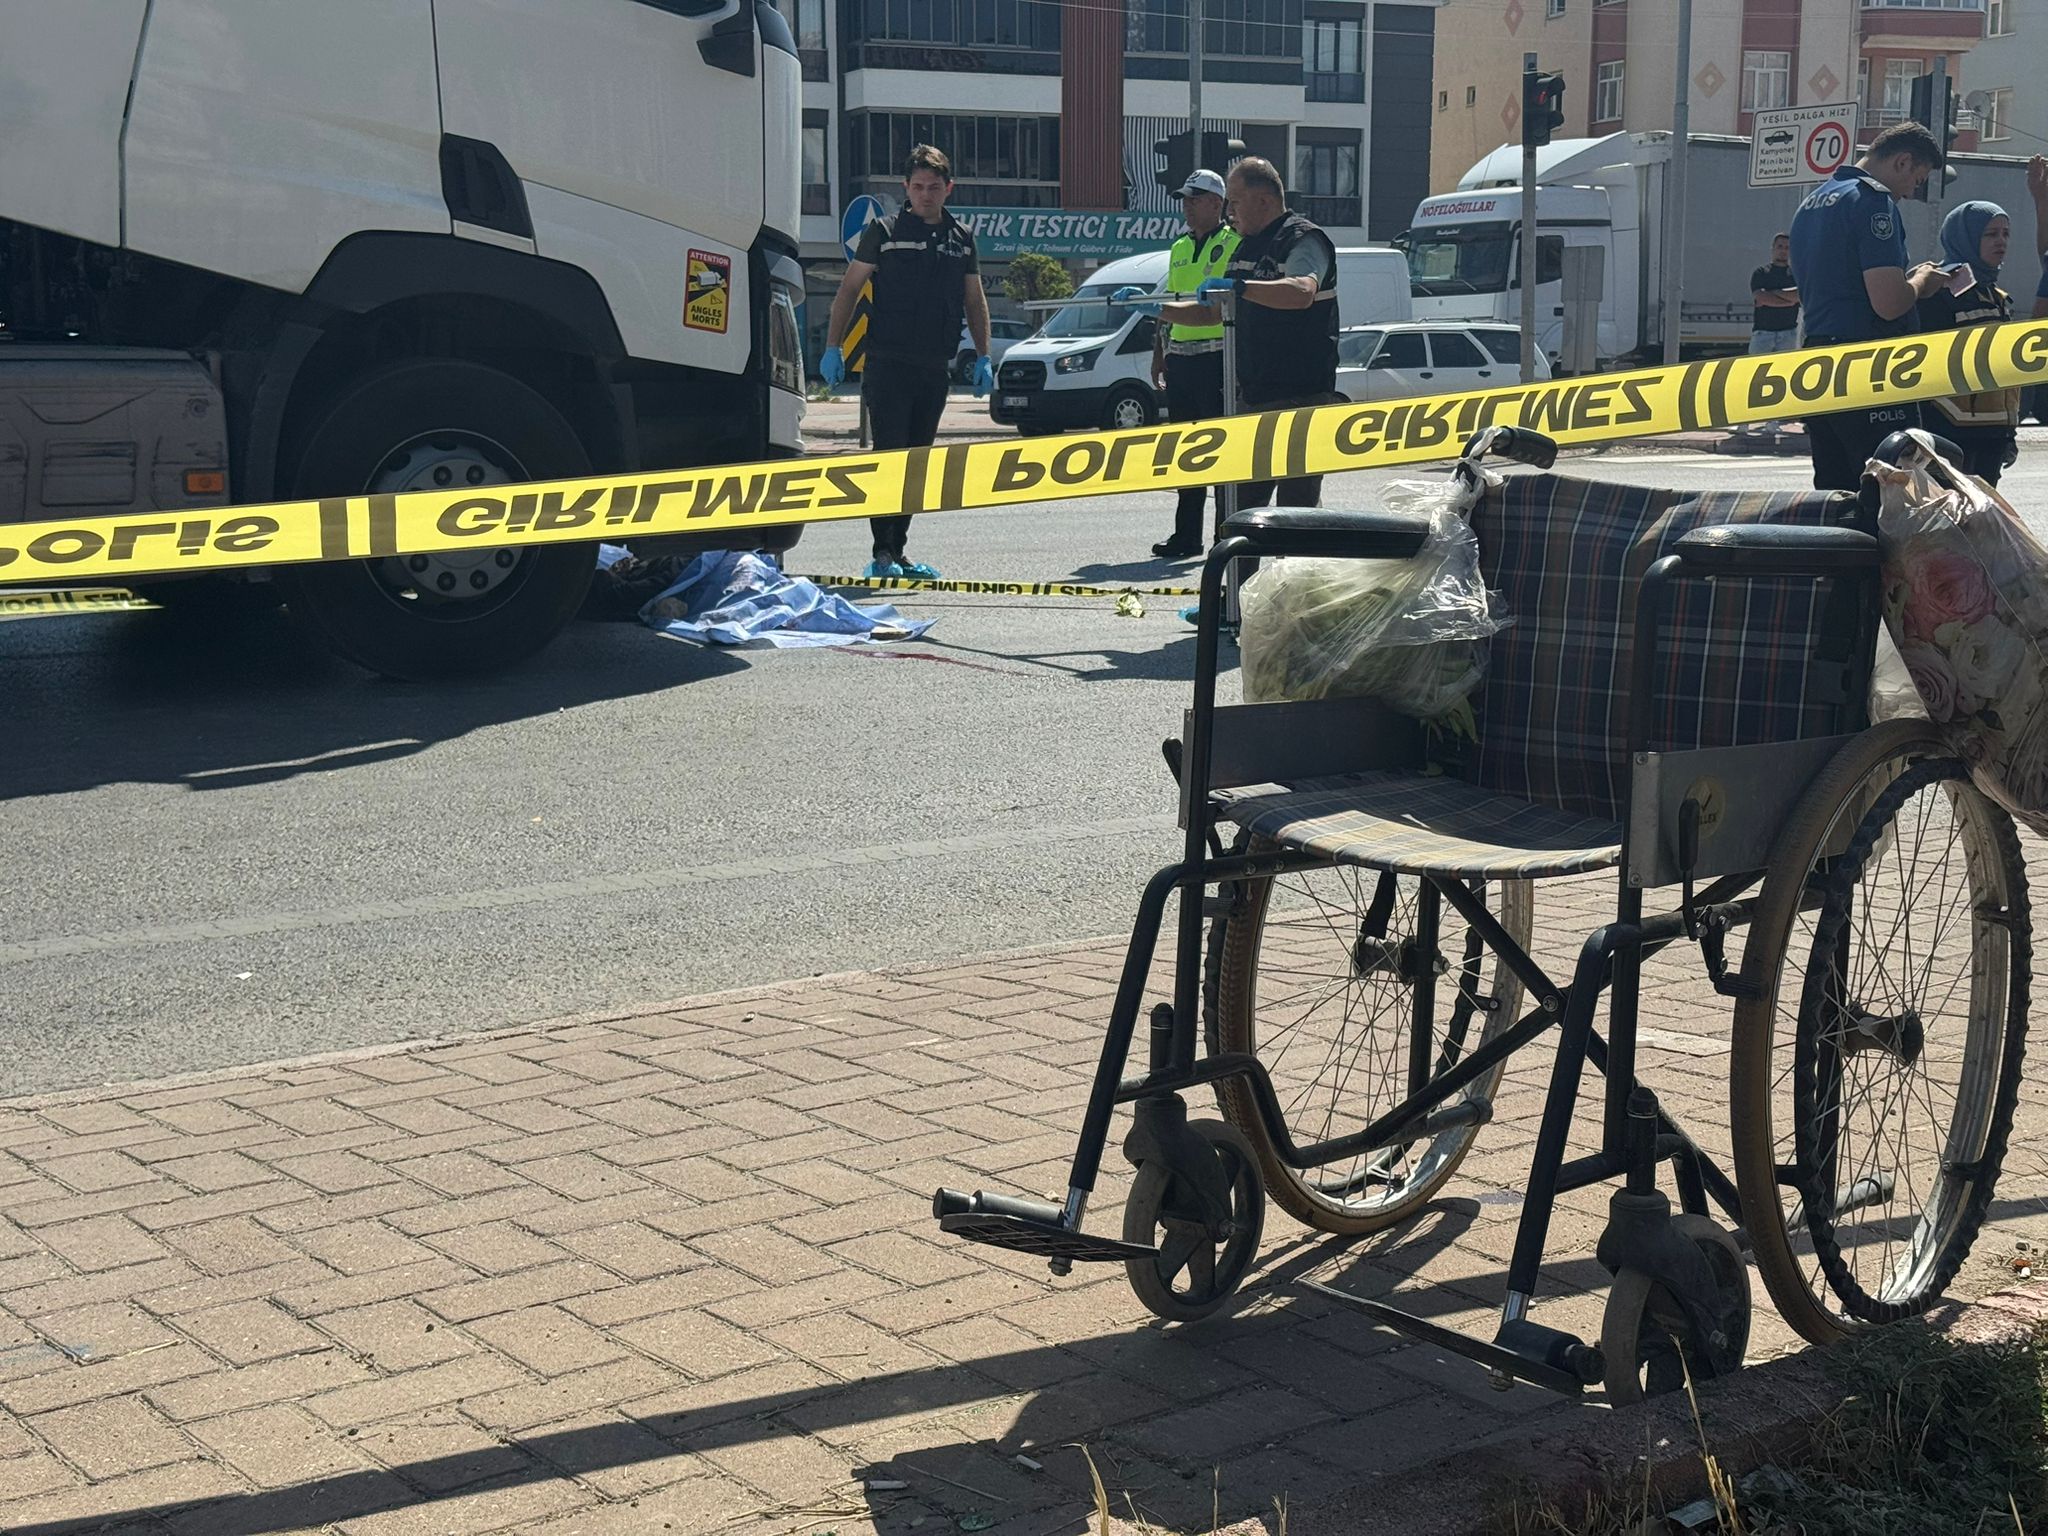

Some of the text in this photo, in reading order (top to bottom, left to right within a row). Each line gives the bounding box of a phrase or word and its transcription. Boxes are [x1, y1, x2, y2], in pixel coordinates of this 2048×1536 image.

[1793, 111, 1825, 121] DALGA
[1829, 108, 1850, 118] HIZI
[1760, 147, 1795, 156] Kamyonet
[1815, 135, 1840, 162] 70
[1759, 167, 1794, 176] Panelvan
[690, 251, 729, 267] ATTENTION
[691, 304, 722, 318] ANGLES
[692, 313, 720, 326] MORTS
